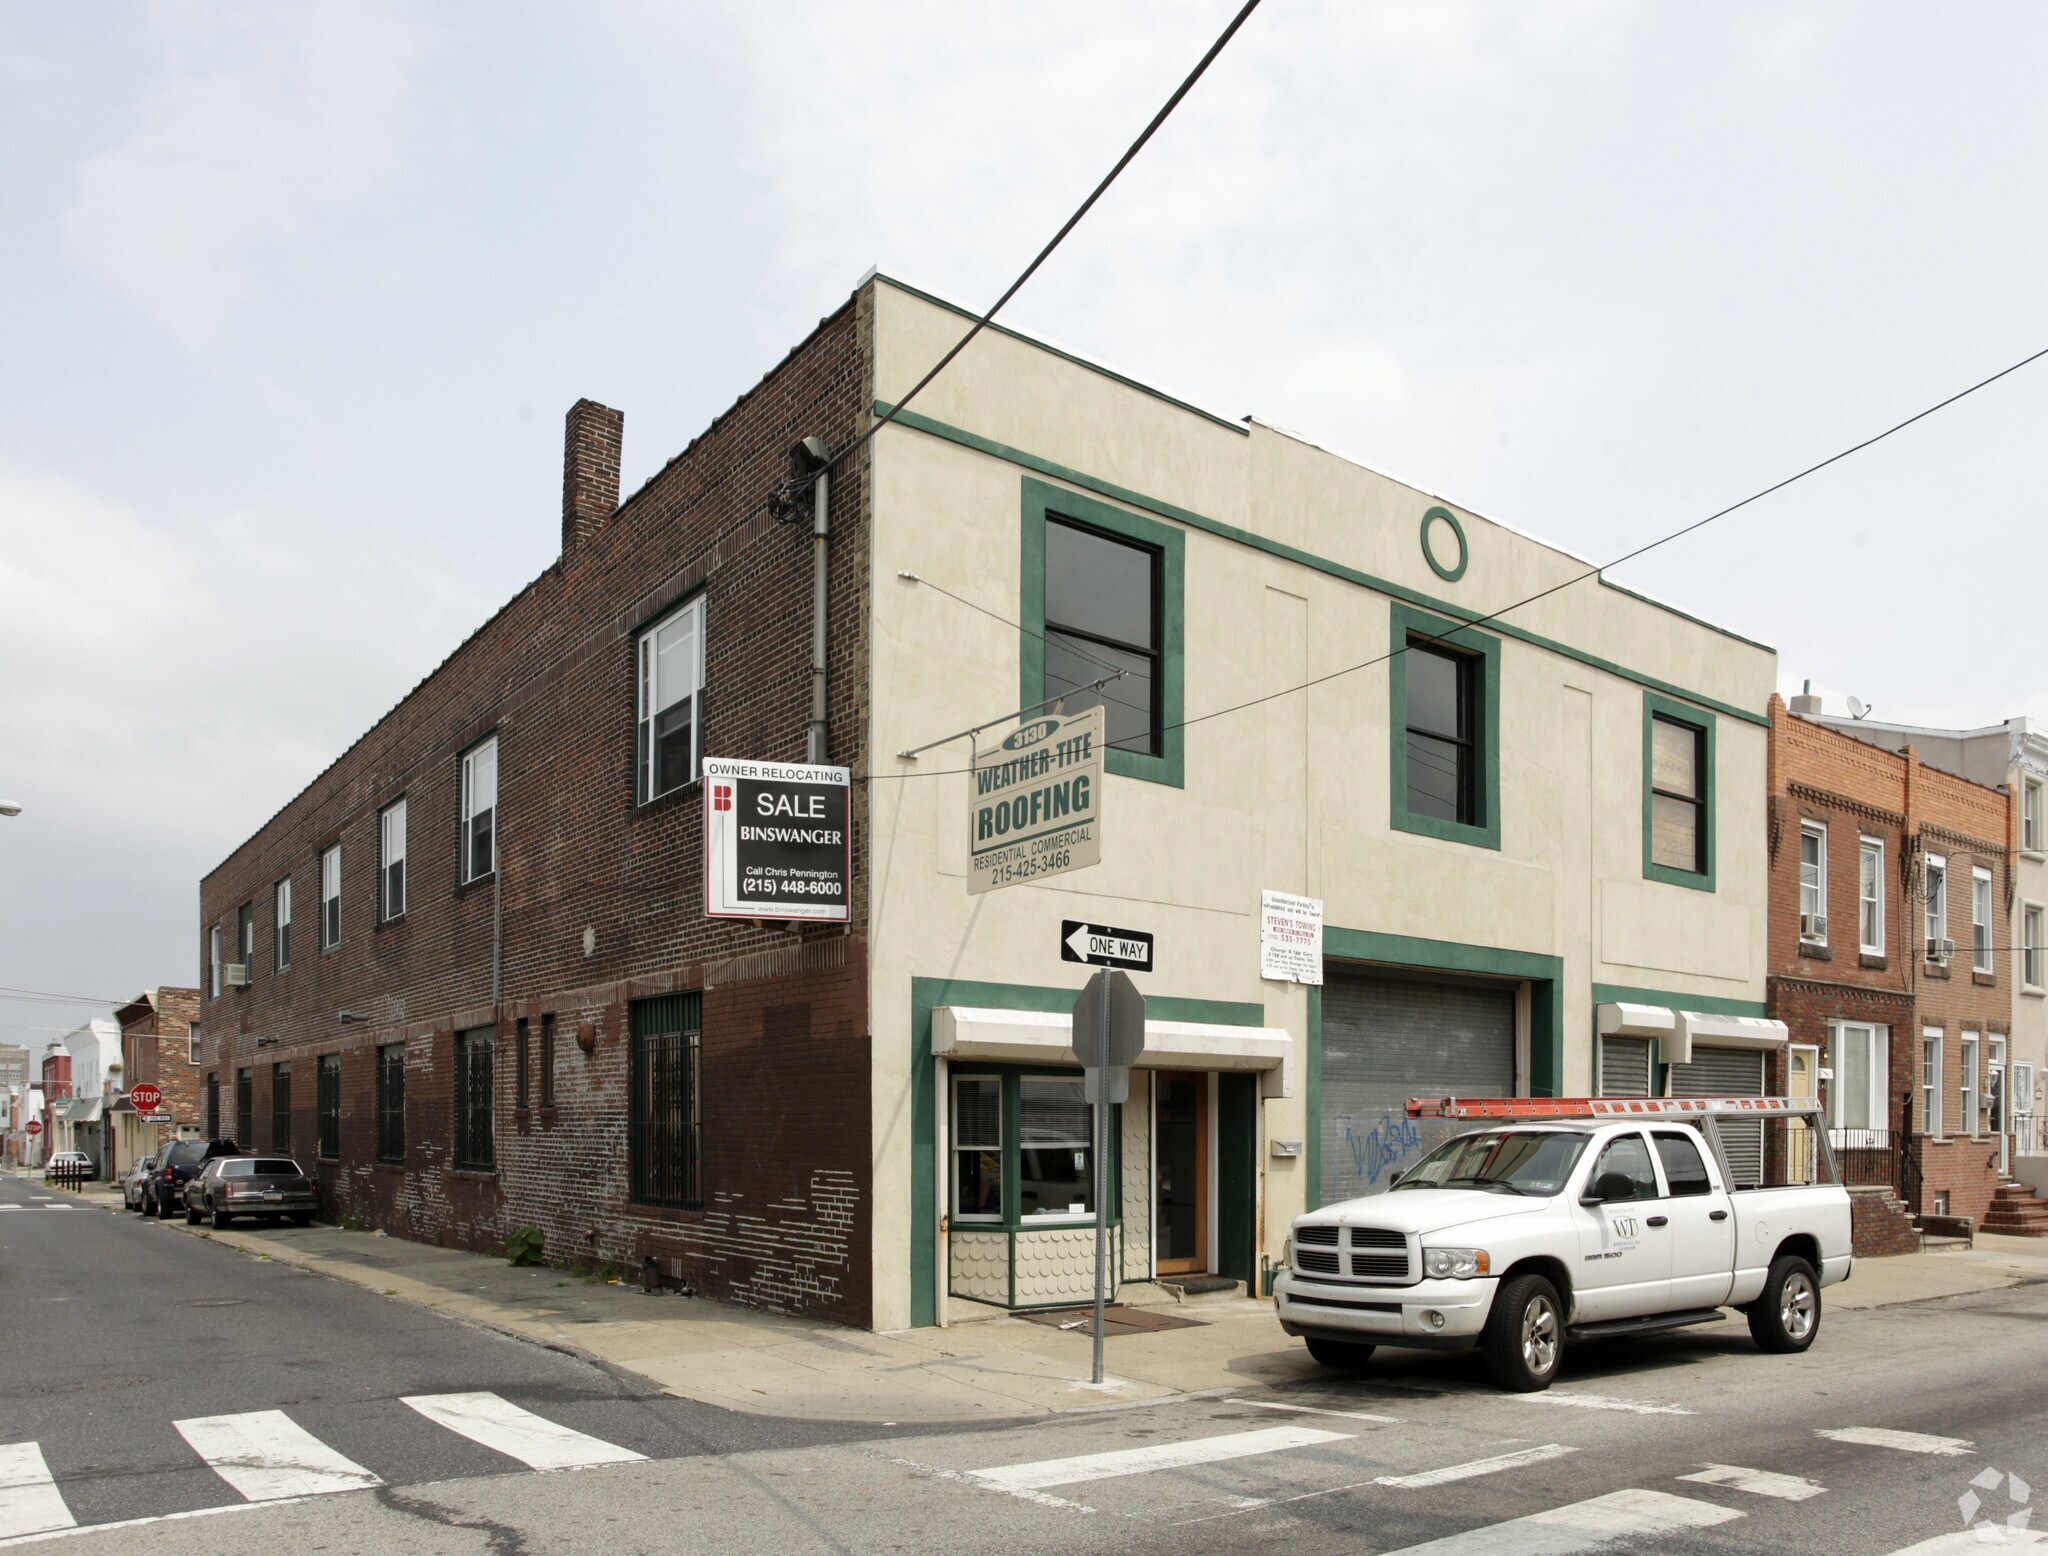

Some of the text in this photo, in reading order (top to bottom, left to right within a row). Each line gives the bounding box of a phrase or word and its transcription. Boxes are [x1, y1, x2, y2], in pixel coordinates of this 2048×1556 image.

[1014, 723, 1047, 748] 3130
[709, 763, 843, 783] OWNER RELOCATING
[977, 731, 1092, 796] WEATHER-TITE
[757, 792, 826, 819] SALE
[978, 775, 1090, 841] ROOFING
[740, 826, 842, 845] BINSWANGER
[974, 827, 1091, 871] RESIDENTIAL COMMERCIAL
[746, 866, 838, 880] Call Chris Pennington
[992, 849, 1070, 885] 215-425-3466
[743, 878, 842, 895] (215) 448-6000
[758, 906, 827, 915] www.binswanger.com
[1267, 915, 1293, 928] STEVEN'S
[1295, 920, 1316, 932] TOWING
[1090, 936, 1144, 959] ONE WAY
[132, 1091, 160, 1103] STOP
[26, 1124, 42, 1132] STOP
[1585, 1251, 1622, 1261] RAM 1500
